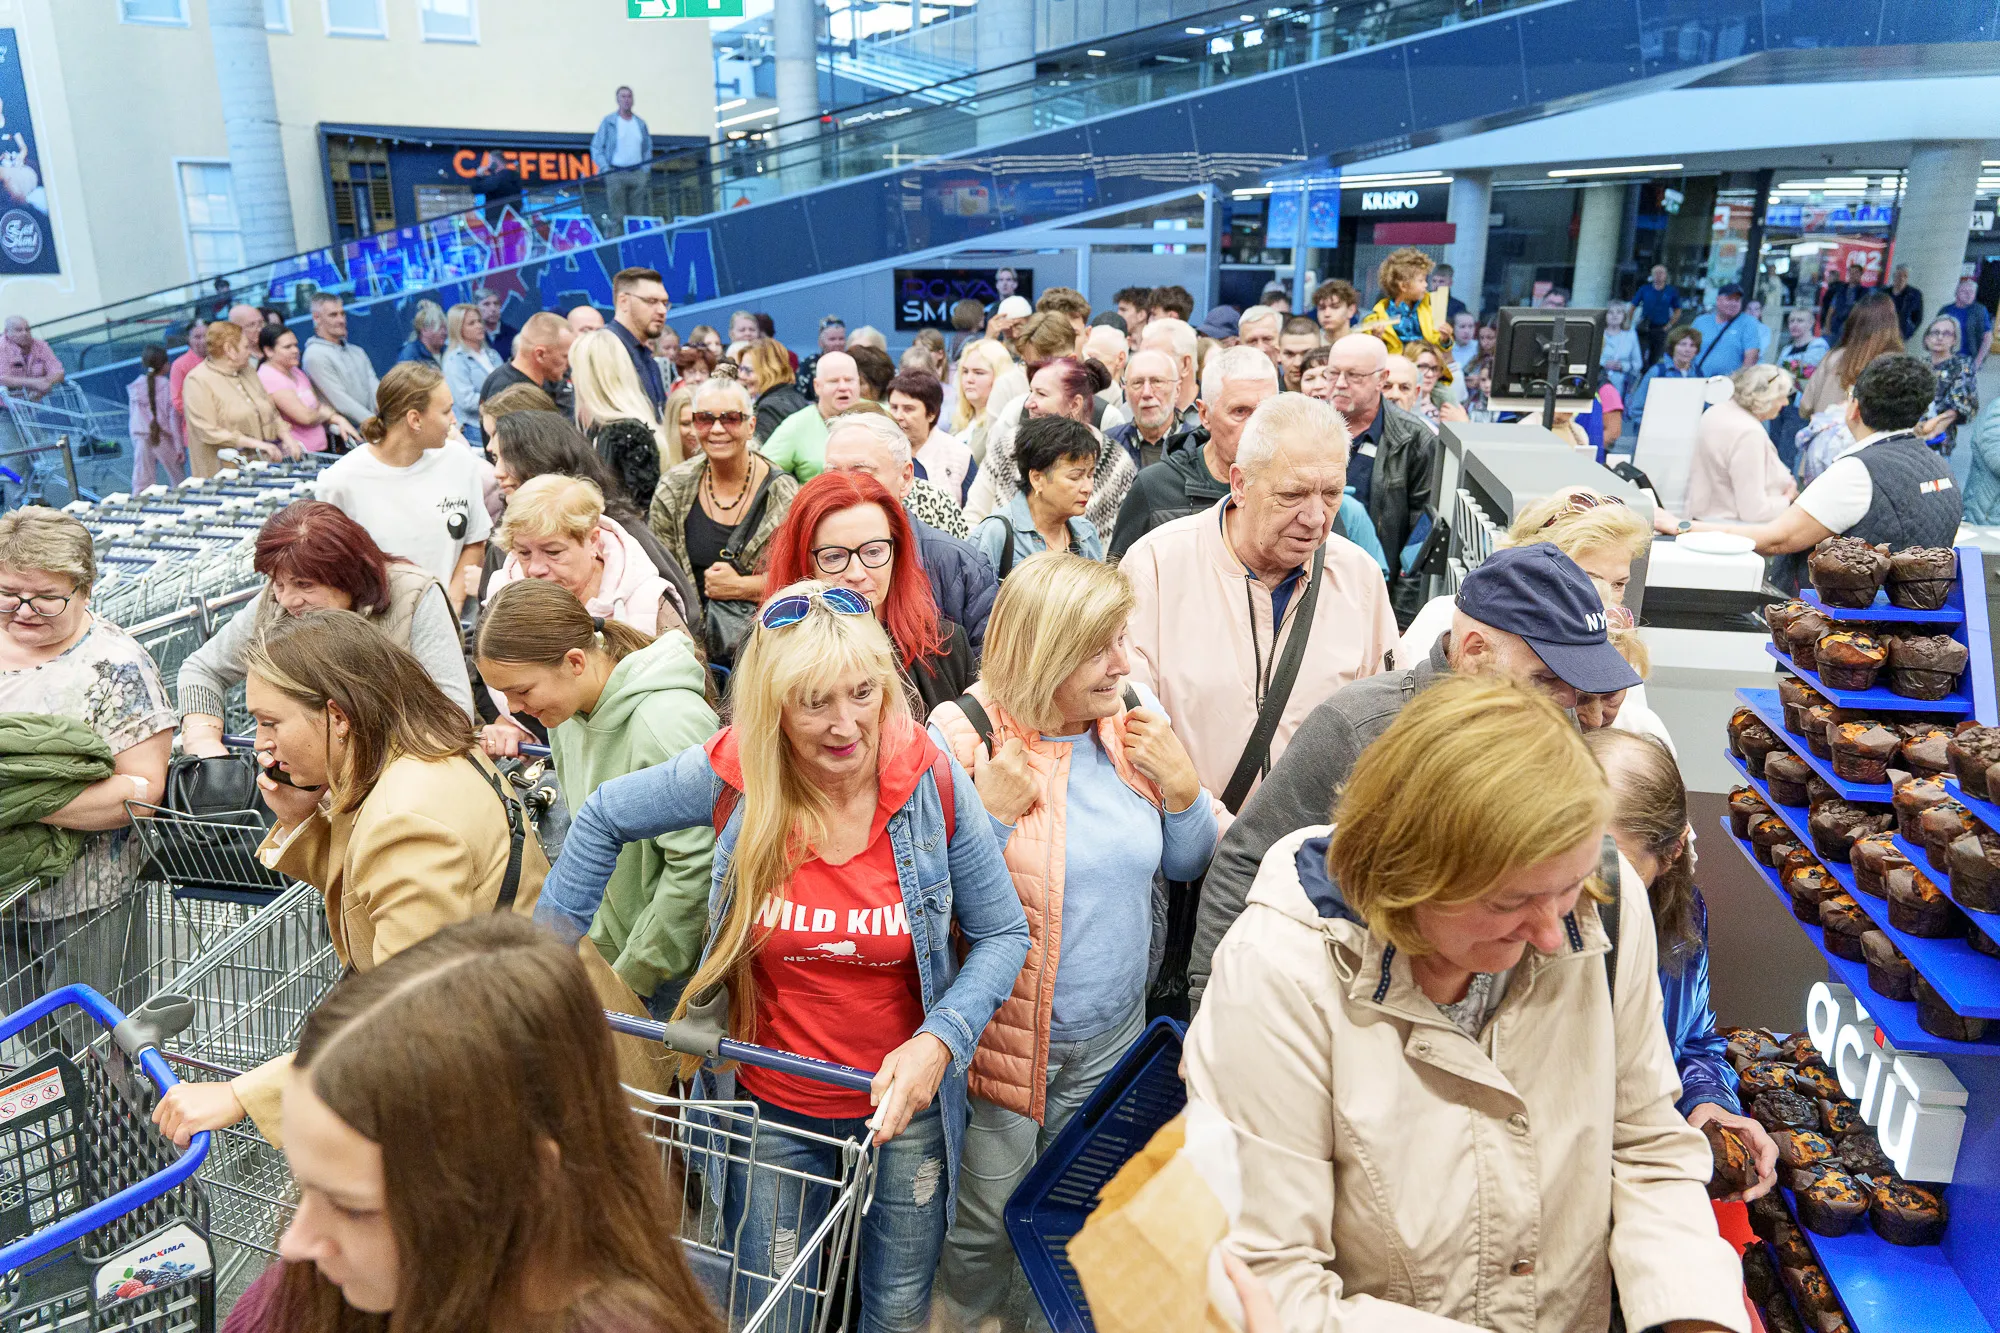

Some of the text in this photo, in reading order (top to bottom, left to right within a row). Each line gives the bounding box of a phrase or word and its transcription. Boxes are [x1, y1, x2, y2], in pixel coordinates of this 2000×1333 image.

[452, 149, 599, 181] CFFEIN
[1362, 190, 1419, 210] KRISPO
[902, 279, 999, 300] ROYA
[1585, 610, 1607, 632] NY
[847, 902, 910, 936] KIW
[827, 958, 902, 967] ALAND
[139, 1243, 186, 1264] MAXIMA
